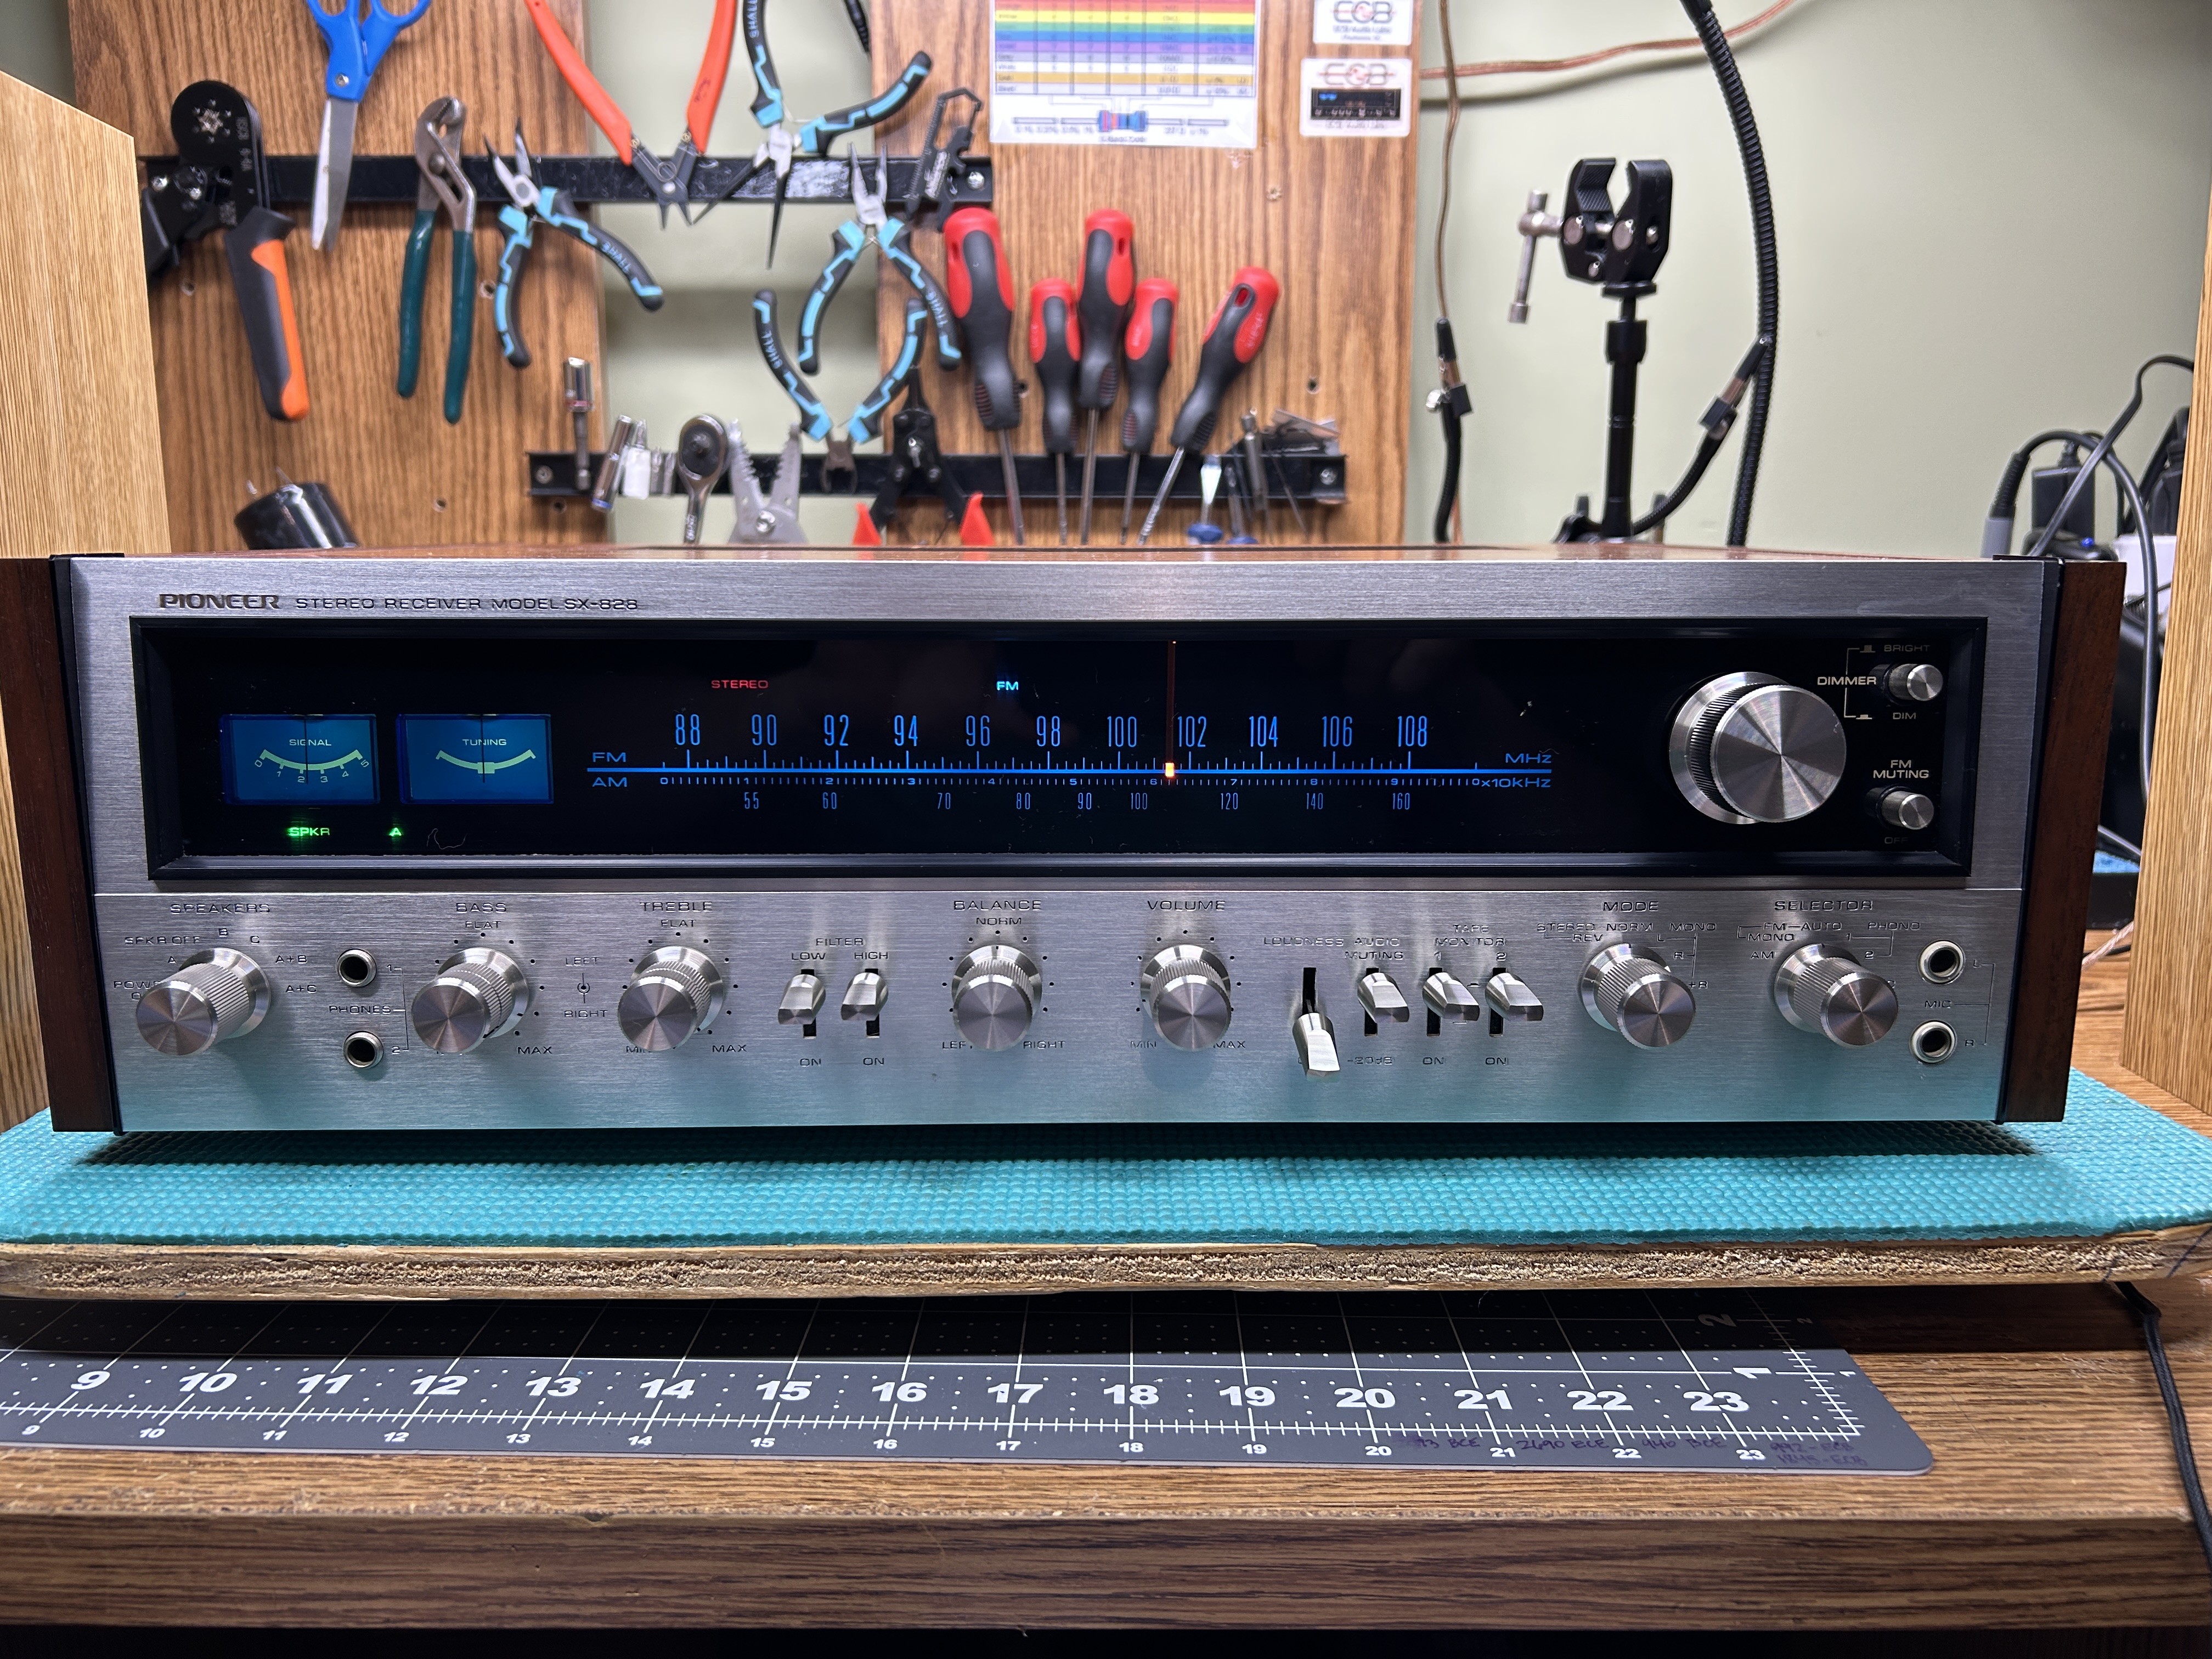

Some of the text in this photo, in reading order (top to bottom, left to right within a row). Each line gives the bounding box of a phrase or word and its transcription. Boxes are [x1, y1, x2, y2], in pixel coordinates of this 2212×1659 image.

[159, 594, 638, 610] PIONEER STEREO RECEIVER MODEL SX-828
[712, 680, 768, 689] STEREO
[1818, 676, 1876, 685] DIMMER
[997, 681, 1018, 690] FM
[676, 714, 1427, 747] 88 90 92 94 96 98 100 102 104 106 108
[593, 752, 1551, 763] FM MHz
[1891, 760, 1911, 768] FM
[1873, 770, 1929, 779] MUTING
[592, 777, 627, 787] AM
[1481, 777, 1550, 787] x10kHz
[744, 792, 1410, 810] 55 60 70 80 90 100 120 140 160
[289, 827, 402, 836] SPKR A
[170, 904, 270, 914] SPEAKERS
[456, 902, 506, 913] BASS
[640, 901, 713, 912] TREBLE
[953, 900, 1042, 911] BALANCE
[1147, 900, 1226, 911] VOLUME
[1602, 901, 1659, 912] MODE
[1774, 900, 1874, 911] SELECTOR
[465, 920, 501, 930] FLAT
[661, 919, 697, 928] FLAT
[975, 917, 1022, 926] NORM
[1867, 922, 1921, 930] PHONO
[1453, 924, 1489, 934] TAPE
[1669, 922, 1717, 932] MONO
[219, 928, 228, 937] B
[1748, 933, 1795, 941] MONO
[125, 936, 200, 945] SPKR OFF
[250, 935, 260, 944] C
[816, 938, 864, 946] FILTER
[1263, 937, 1344, 947] LOUDNESS
[1355, 937, 1401, 947] AUDIO
[1434, 937, 1506, 947] MONITOR
[1572, 934, 1604, 943] REV
[167, 956, 177, 964] A
[275, 955, 307, 964] A+B
[791, 951, 889, 961] LOW HIGH
[1344, 951, 1404, 961] MUTING
[1434, 951, 1507, 961] 1 2
[1673, 951, 1684, 960] R
[1750, 951, 1774, 960] AM
[1865, 951, 1874, 960] 2
[566, 957, 600, 966] LEFT
[285, 985, 317, 994] A+C
[1925, 1000, 1951, 1008] MIC
[329, 1005, 391, 1015] PHONES
[564, 1009, 608, 1018] RIGHT
[712, 1045, 747, 1053] MAX
[1023, 1040, 1066, 1049] RIGHT
[1130, 1041, 1157, 1049] MIN
[392, 1046, 400, 1054] 2
[517, 1046, 553, 1055] MAX
[799, 1057, 885, 1066] ON ON
[1423, 1057, 1508, 1065] ON ON
[71, 1371, 1751, 1412] 9 10 11 12 13 14 15 16 17 18 19 20 21 22 23
[22, 1425, 40, 1435] 9
[140, 1428, 165, 1438] 10
[263, 1430, 287, 1441] 11
[384, 1432, 409, 1442] 12
[506, 1434, 531, 1444] 13
[628, 1436, 652, 1446] 14
[751, 1438, 775, 1448] 15
[873, 1439, 898, 1449] 16
[996, 1441, 1021, 1451] 17
[1119, 1442, 1143, 1453] 18
[1242, 1444, 1267, 1454] 19
[1365, 1446, 1393, 1457] 20
[1490, 1448, 1516, 1458] 21
[1612, 1448, 1643, 1459] 22
[1736, 1449, 1767, 1460] 23
